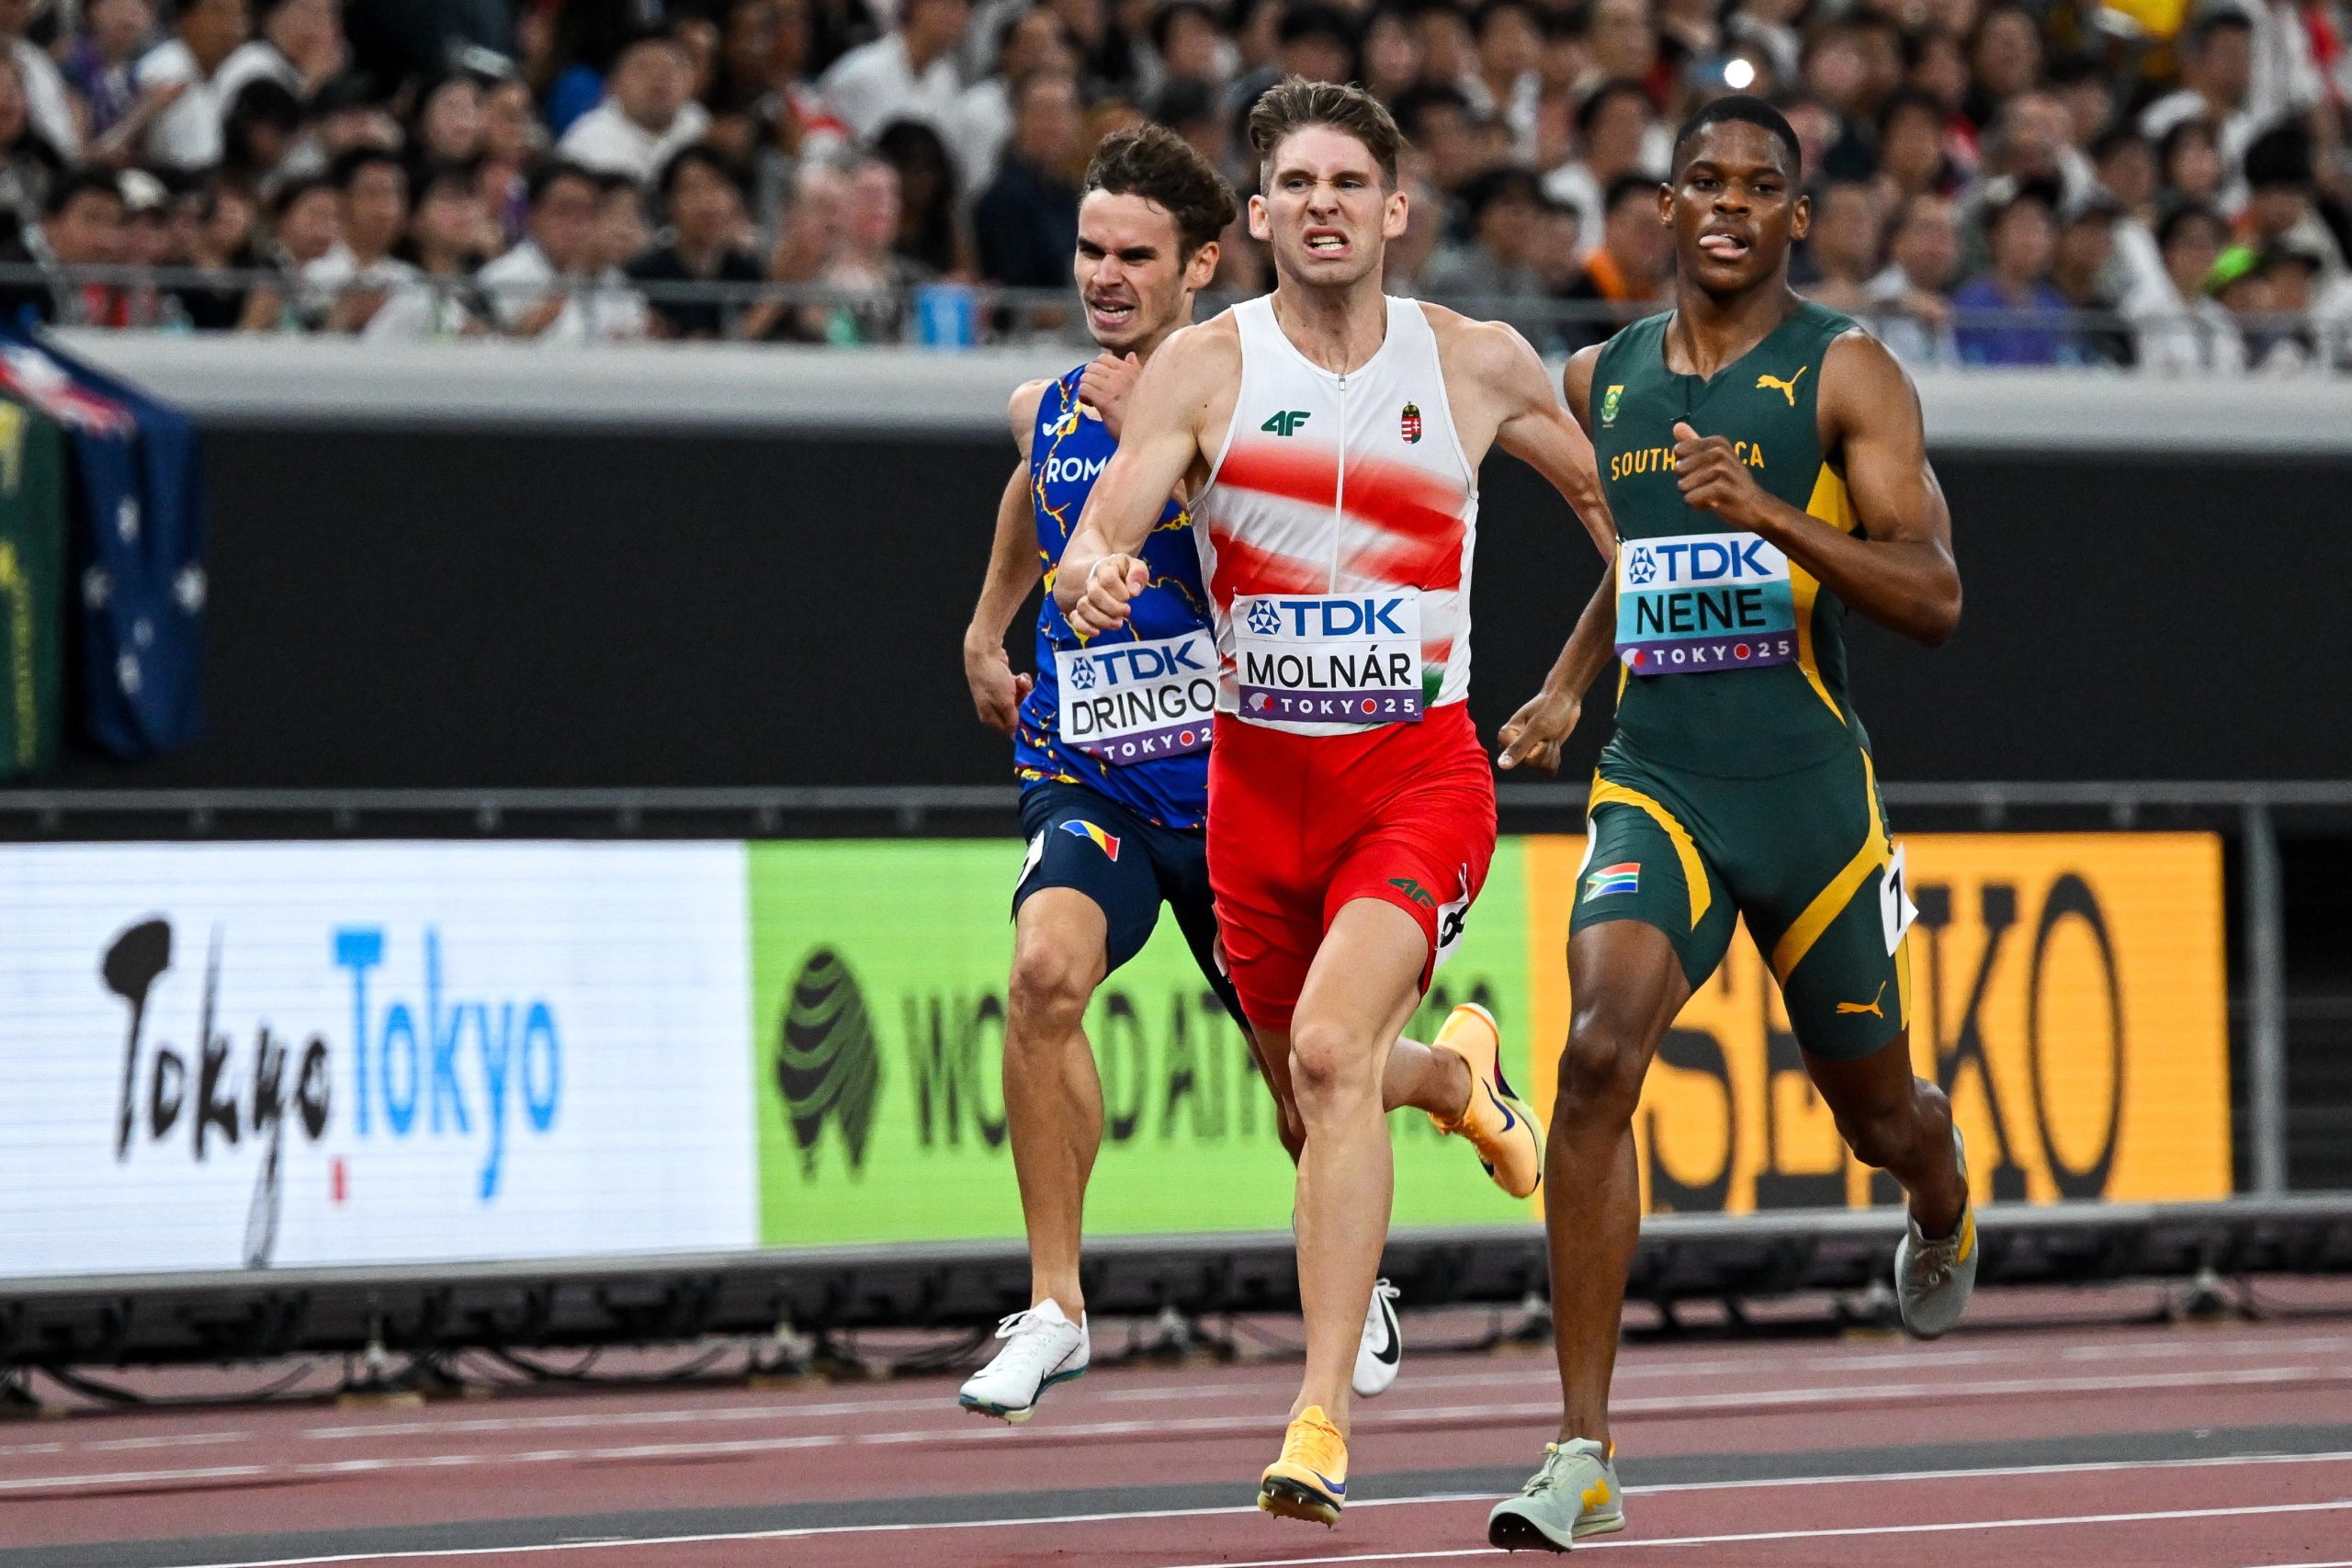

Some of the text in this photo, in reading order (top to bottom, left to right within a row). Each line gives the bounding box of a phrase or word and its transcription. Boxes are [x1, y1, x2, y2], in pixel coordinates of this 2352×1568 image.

[1611, 447, 1677, 481] SOUTH
[1656, 539, 1772, 582] TDK
[1280, 598, 1407, 637] TDK
[1636, 587, 1767, 635] NENE
[1092, 638, 1206, 686] TDK
[1246, 645, 1411, 688] MOLNÁR
[1071, 678, 1216, 736] DRINGO
[1650, 871, 2126, 1213] SEKO
[100, 913, 561, 1269] Tokyo Tokyo
[899, 990, 1148, 1146] WOD
